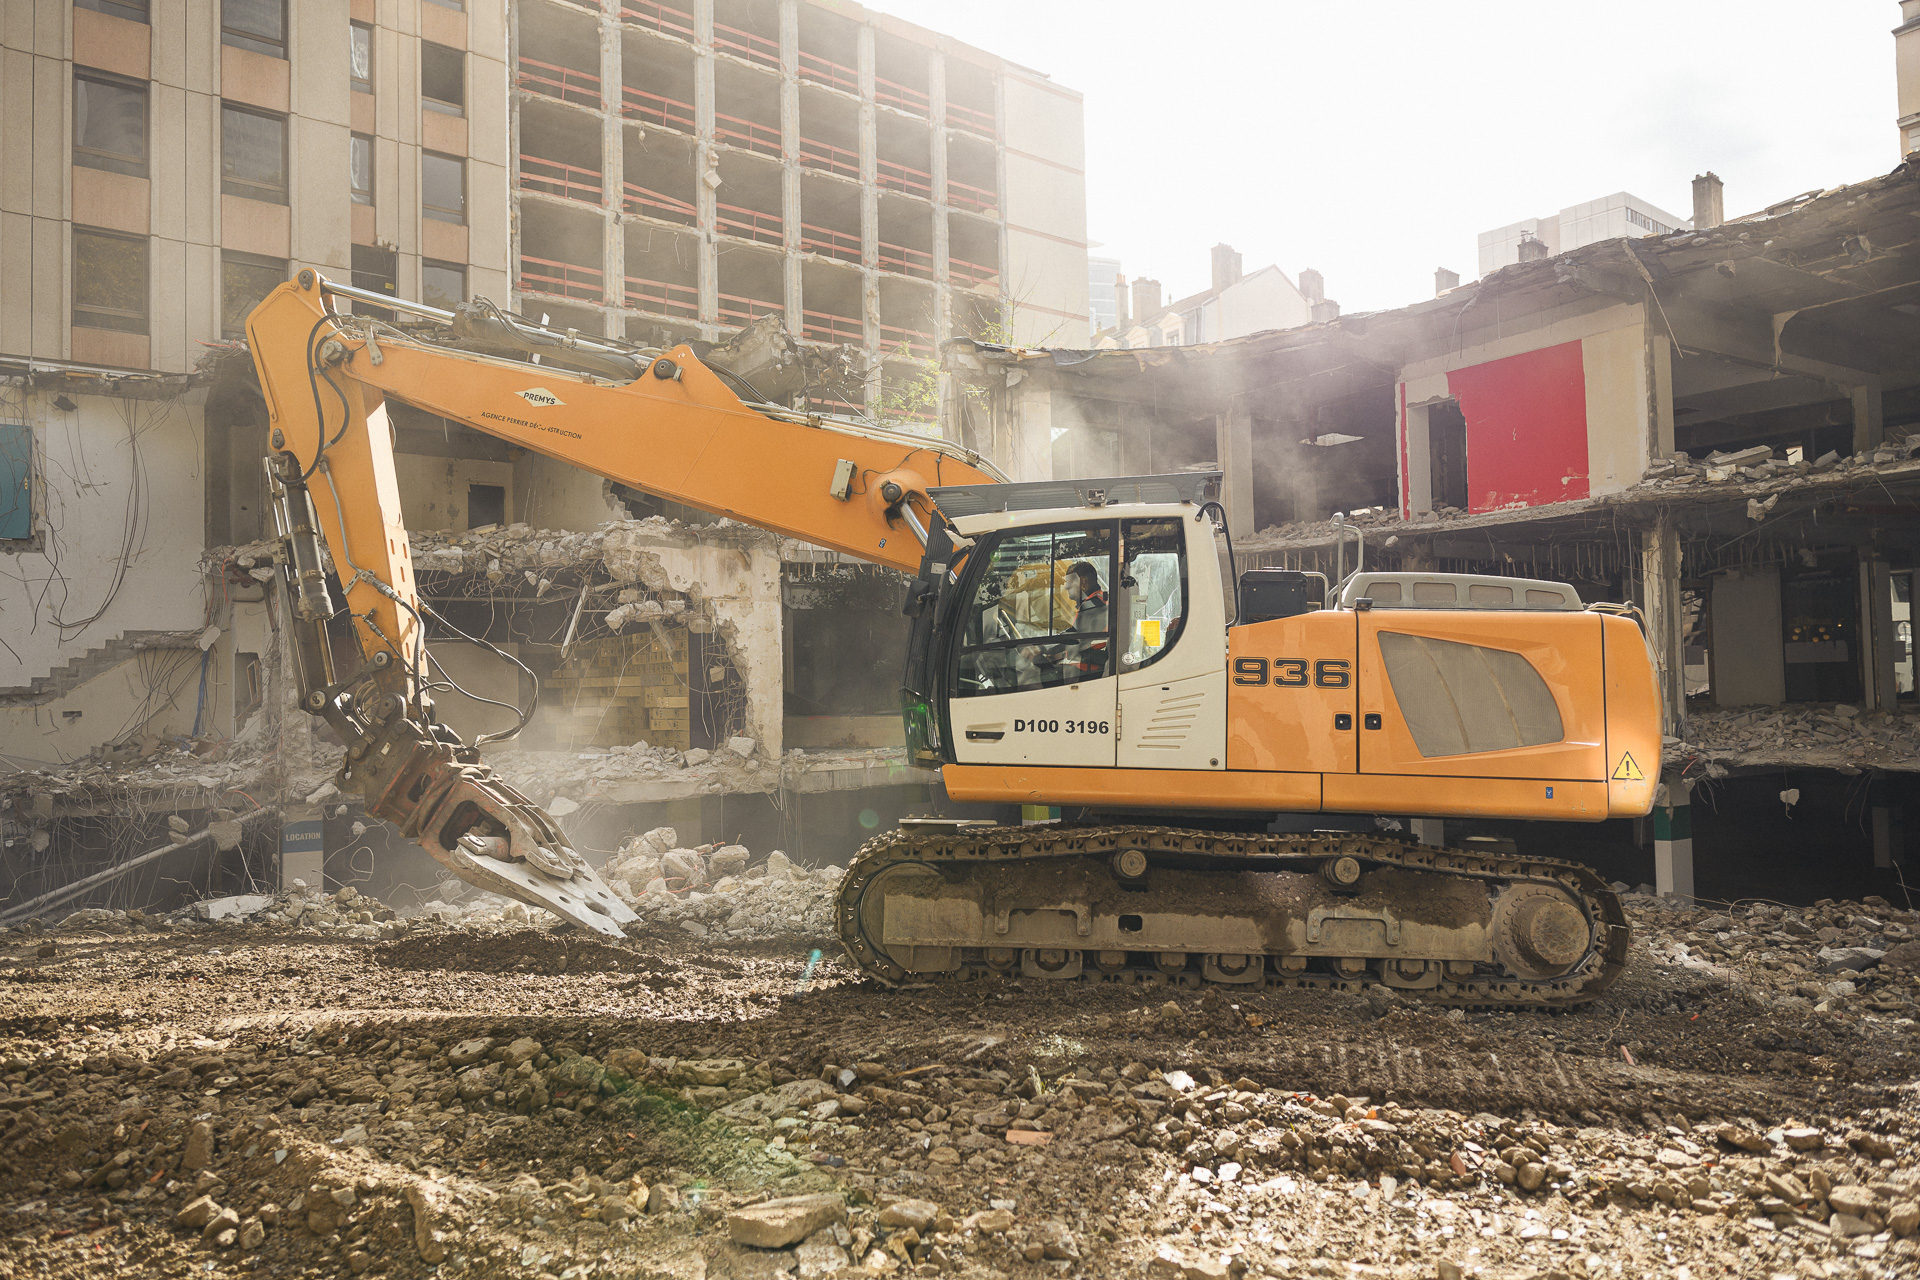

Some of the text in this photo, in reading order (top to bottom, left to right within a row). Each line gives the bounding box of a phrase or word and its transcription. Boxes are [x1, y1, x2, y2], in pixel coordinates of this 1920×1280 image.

[523, 392, 556, 405] PREMYS
[481, 411, 506, 422] AGENCE
[506, 417, 529, 427] PERRIER
[1232, 656, 1352, 690] 936
[1014, 719, 1109, 734] D100 3196
[285, 832, 321, 842] LOCATION
